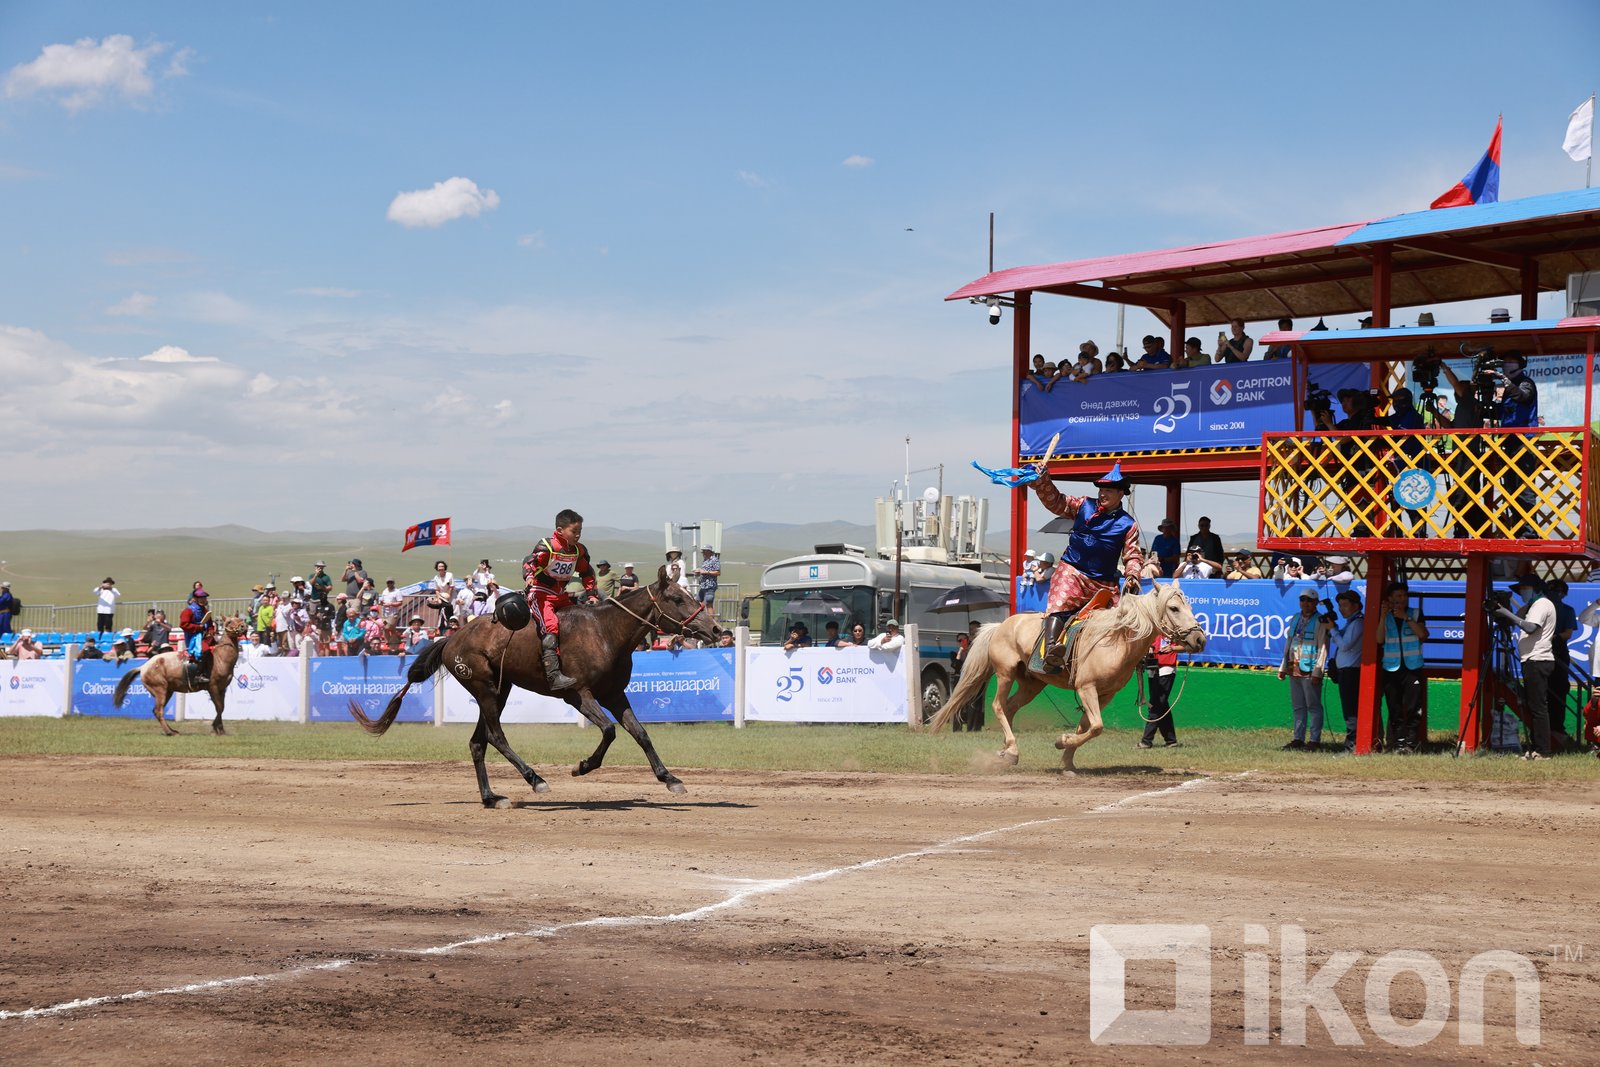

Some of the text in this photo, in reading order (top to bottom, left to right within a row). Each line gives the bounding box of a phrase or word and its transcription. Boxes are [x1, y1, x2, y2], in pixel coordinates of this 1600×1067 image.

[1521, 364, 1584, 378] ОЛНООРОО
[1236, 376, 1291, 390] CAPITRON
[1236, 391, 1265, 403] BANK
[1080, 399, 1140, 410] Өнөд дэвжих,
[1153, 381, 1192, 434] 25
[1068, 412, 1140, 424] өсөлтийн түүчээ
[1209, 421, 1245, 431] since 2001
[407, 524, 447, 544] MNB
[551, 562, 573, 575] 288
[1211, 597, 1260, 607] түмнээрээ
[322, 680, 361, 695] Сайхан
[651, 676, 720, 696] наадаарай
[776, 666, 805, 702] 25
